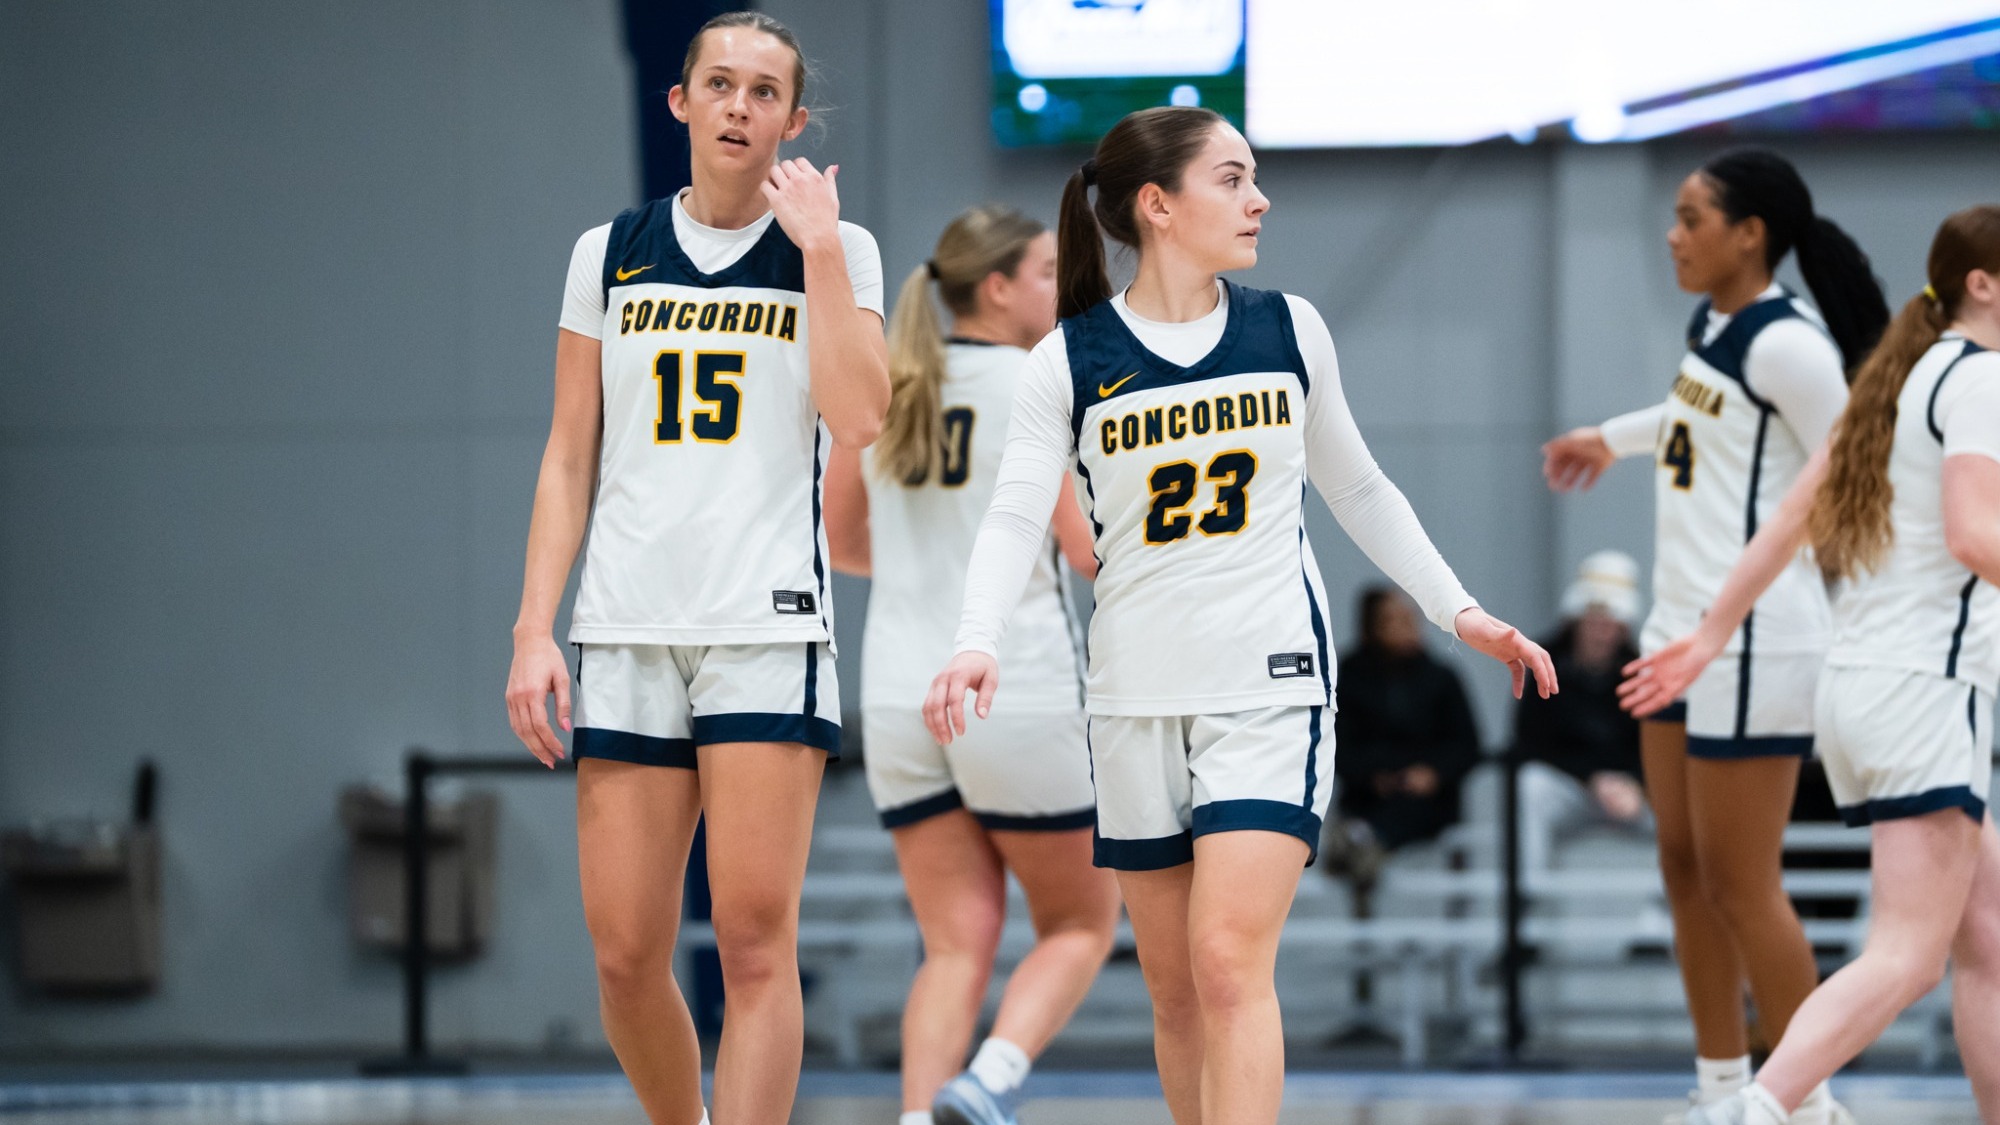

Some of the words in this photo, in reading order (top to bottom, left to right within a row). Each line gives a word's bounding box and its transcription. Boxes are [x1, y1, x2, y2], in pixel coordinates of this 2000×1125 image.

[620, 299, 797, 342] CONCORDIA
[653, 349, 746, 444] 15
[1100, 388, 1292, 455] CONCORDIA
[1144, 448, 1259, 545] 23
[802, 598, 809, 608] L
[1300, 660, 1309, 670] M
